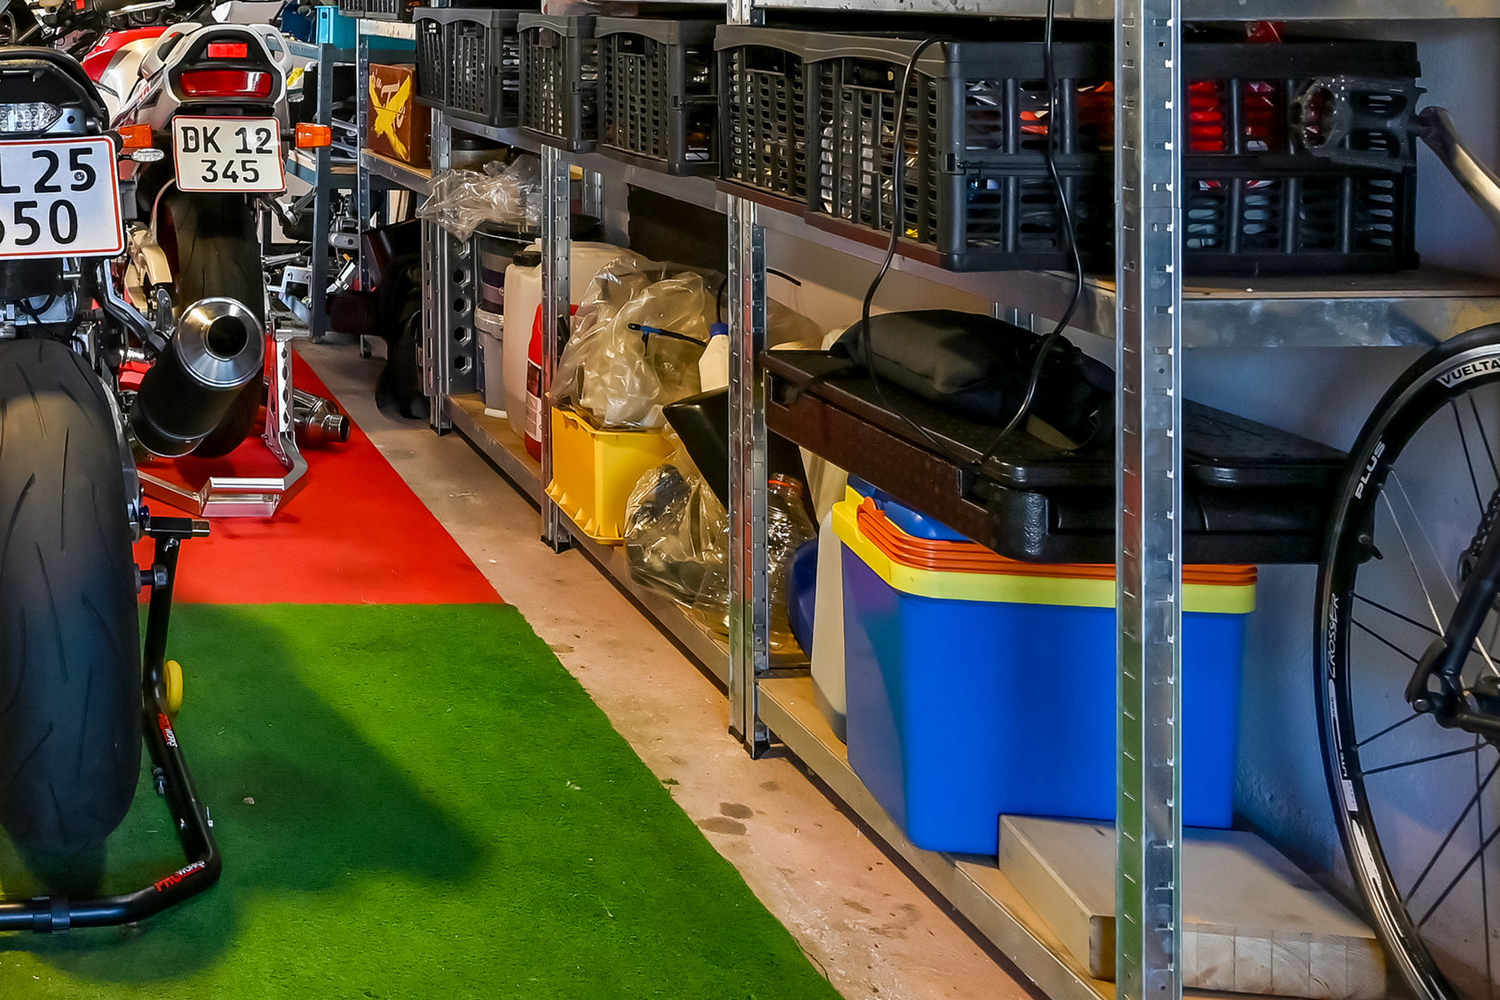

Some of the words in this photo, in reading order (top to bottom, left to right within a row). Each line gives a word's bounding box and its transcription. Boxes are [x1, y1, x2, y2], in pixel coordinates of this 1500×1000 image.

[180, 126, 221, 153] DK
[235, 127, 273, 154] 12
[201, 159, 260, 183] 345
[1440, 359, 1500, 385] VUELTA
[1354, 440, 1386, 500] PLUS
